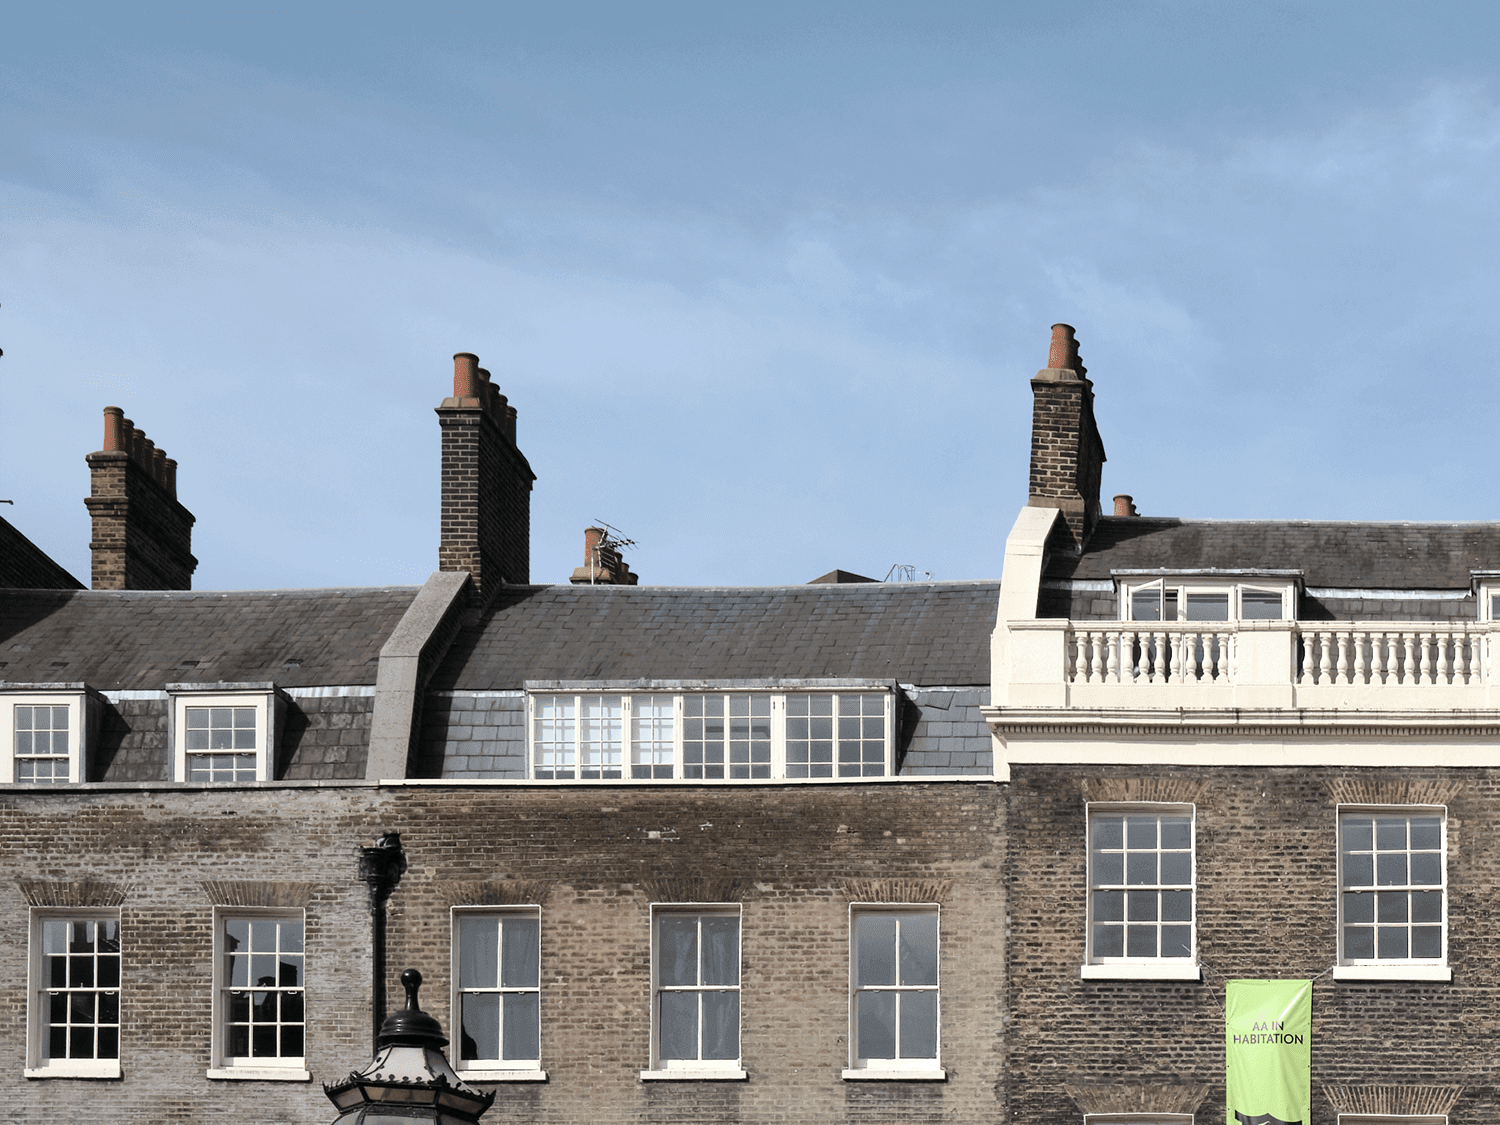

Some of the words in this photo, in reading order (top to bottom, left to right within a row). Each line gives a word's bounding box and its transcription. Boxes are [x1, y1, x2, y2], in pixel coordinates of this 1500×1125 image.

[1253, 1021, 1268, 1031] AA
[1271, 1021, 1284, 1031] IN
[1233, 1033, 1304, 1045] HABITATION
